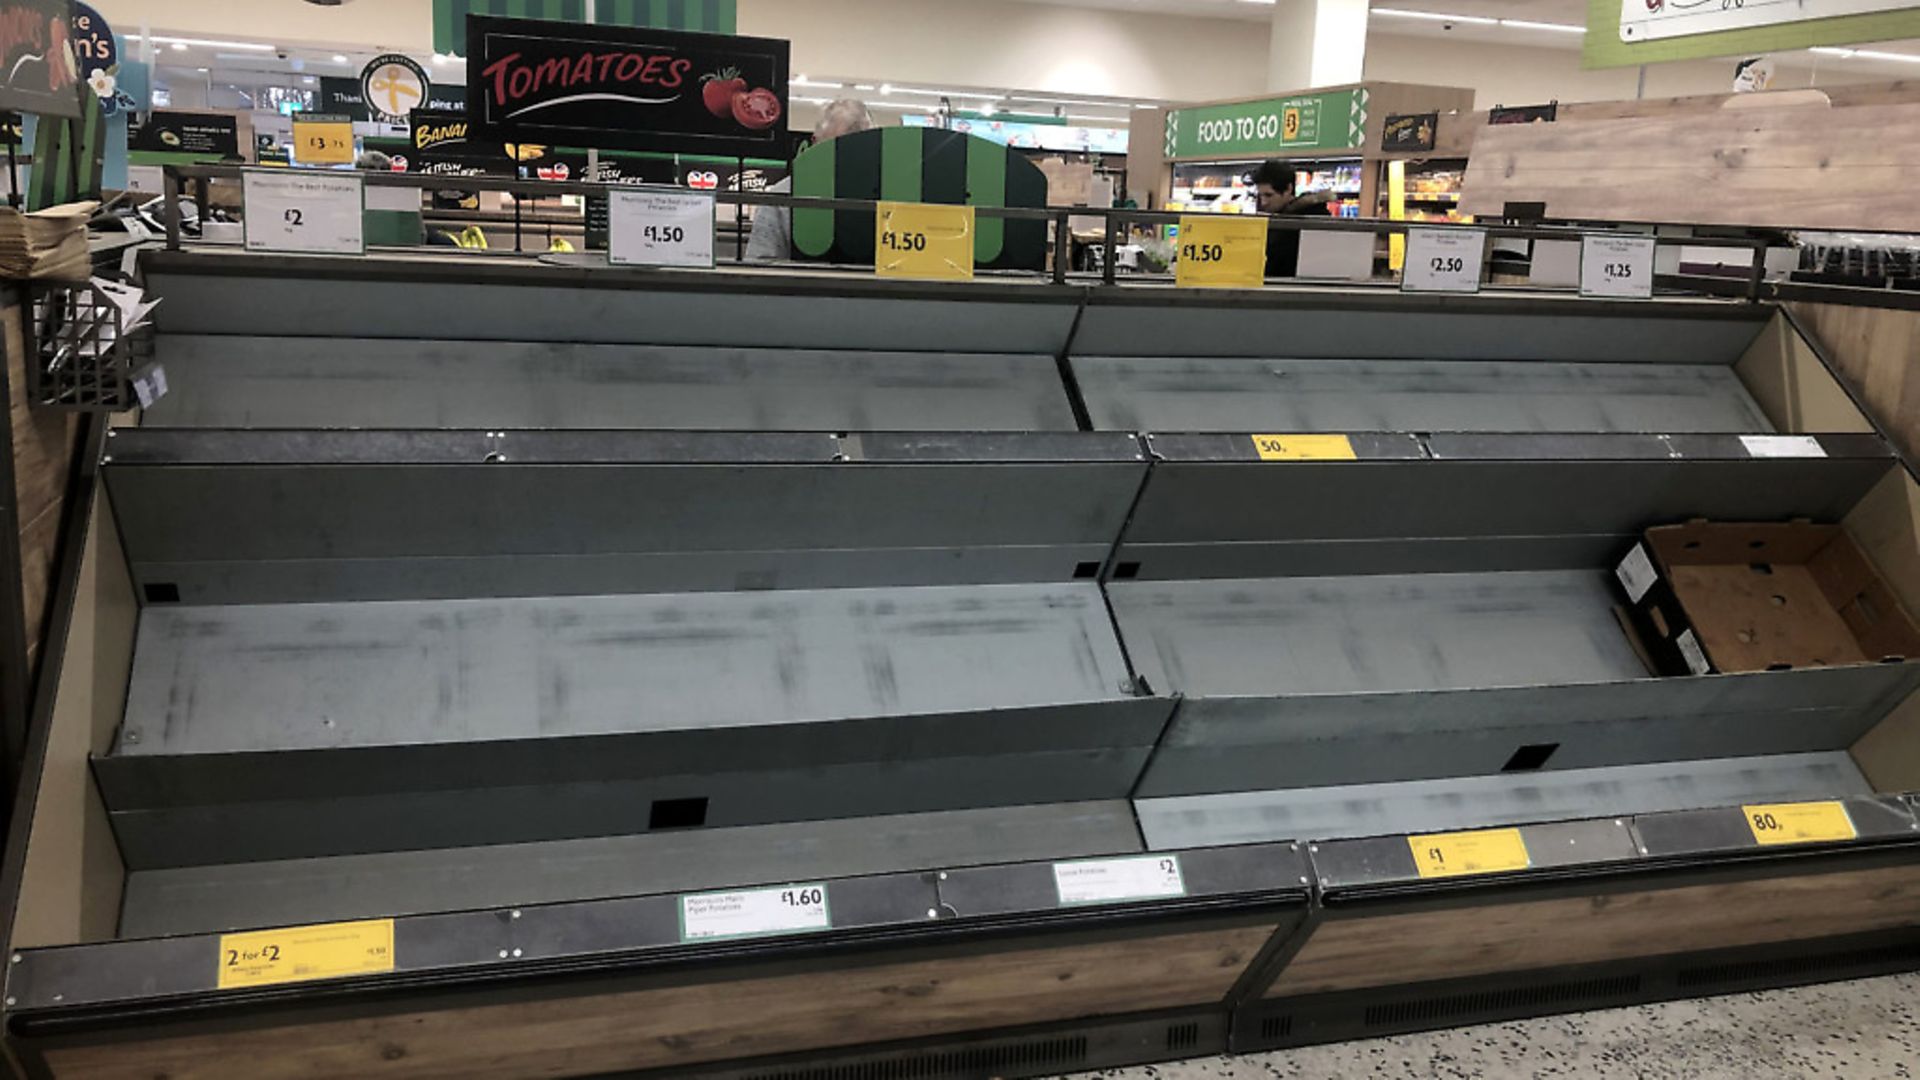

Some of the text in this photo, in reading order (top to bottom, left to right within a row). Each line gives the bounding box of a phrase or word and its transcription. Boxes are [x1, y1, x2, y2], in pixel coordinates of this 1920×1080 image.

[482, 53, 692, 105] TOMATOES
[1197, 119, 1233, 142] FOOD
[1235, 116, 1254, 139] TO
[1256, 113, 1279, 139] GO
[284, 208, 304, 226] £2
[643, 225, 685, 243] £1.50
[882, 231, 927, 252] £1.50
[1183, 244, 1223, 262] £1.50
[1430, 257, 1463, 273] £2.50
[1160, 858, 1176, 875] £2
[781, 889, 822, 907] £1.60
[227, 945, 281, 967] 2 for £2
